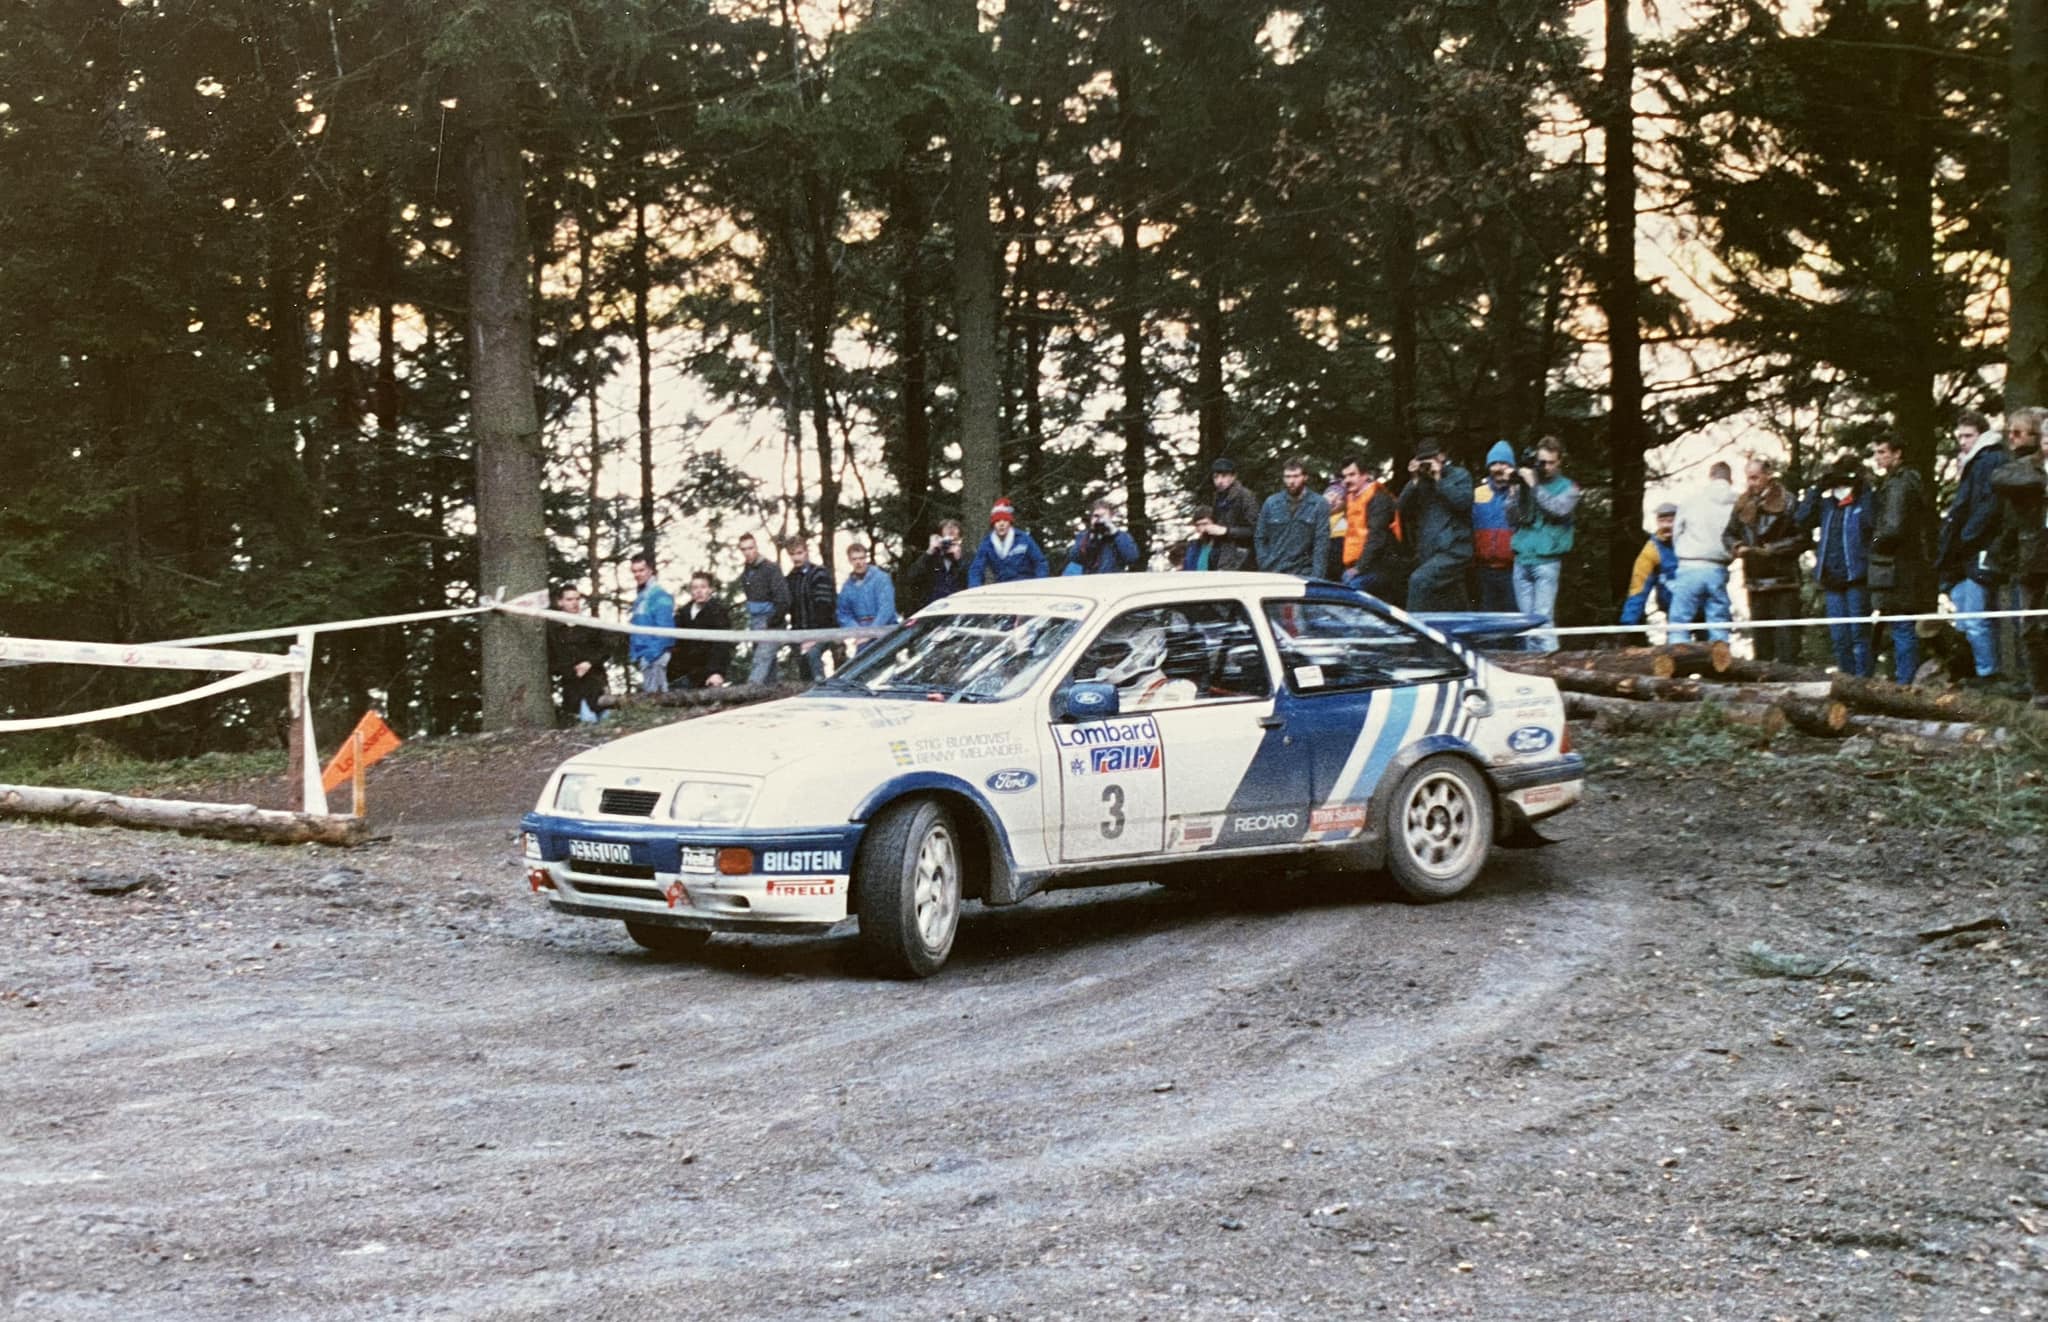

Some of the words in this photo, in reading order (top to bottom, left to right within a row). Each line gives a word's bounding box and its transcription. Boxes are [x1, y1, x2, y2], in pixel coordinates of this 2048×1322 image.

[1055, 718, 1156, 746] Lombard
[915, 738, 942, 752] STIG
[916, 750, 955, 764] BENNY
[960, 743, 1023, 760] MELANDER
[1094, 745, 1156, 772] rally
[994, 772, 1029, 789] Ford
[1101, 784, 1126, 839] 3
[1234, 814, 1298, 832] RECARO
[763, 850, 843, 872] BILSTEIN
[766, 879, 835, 896] PIRELLI
